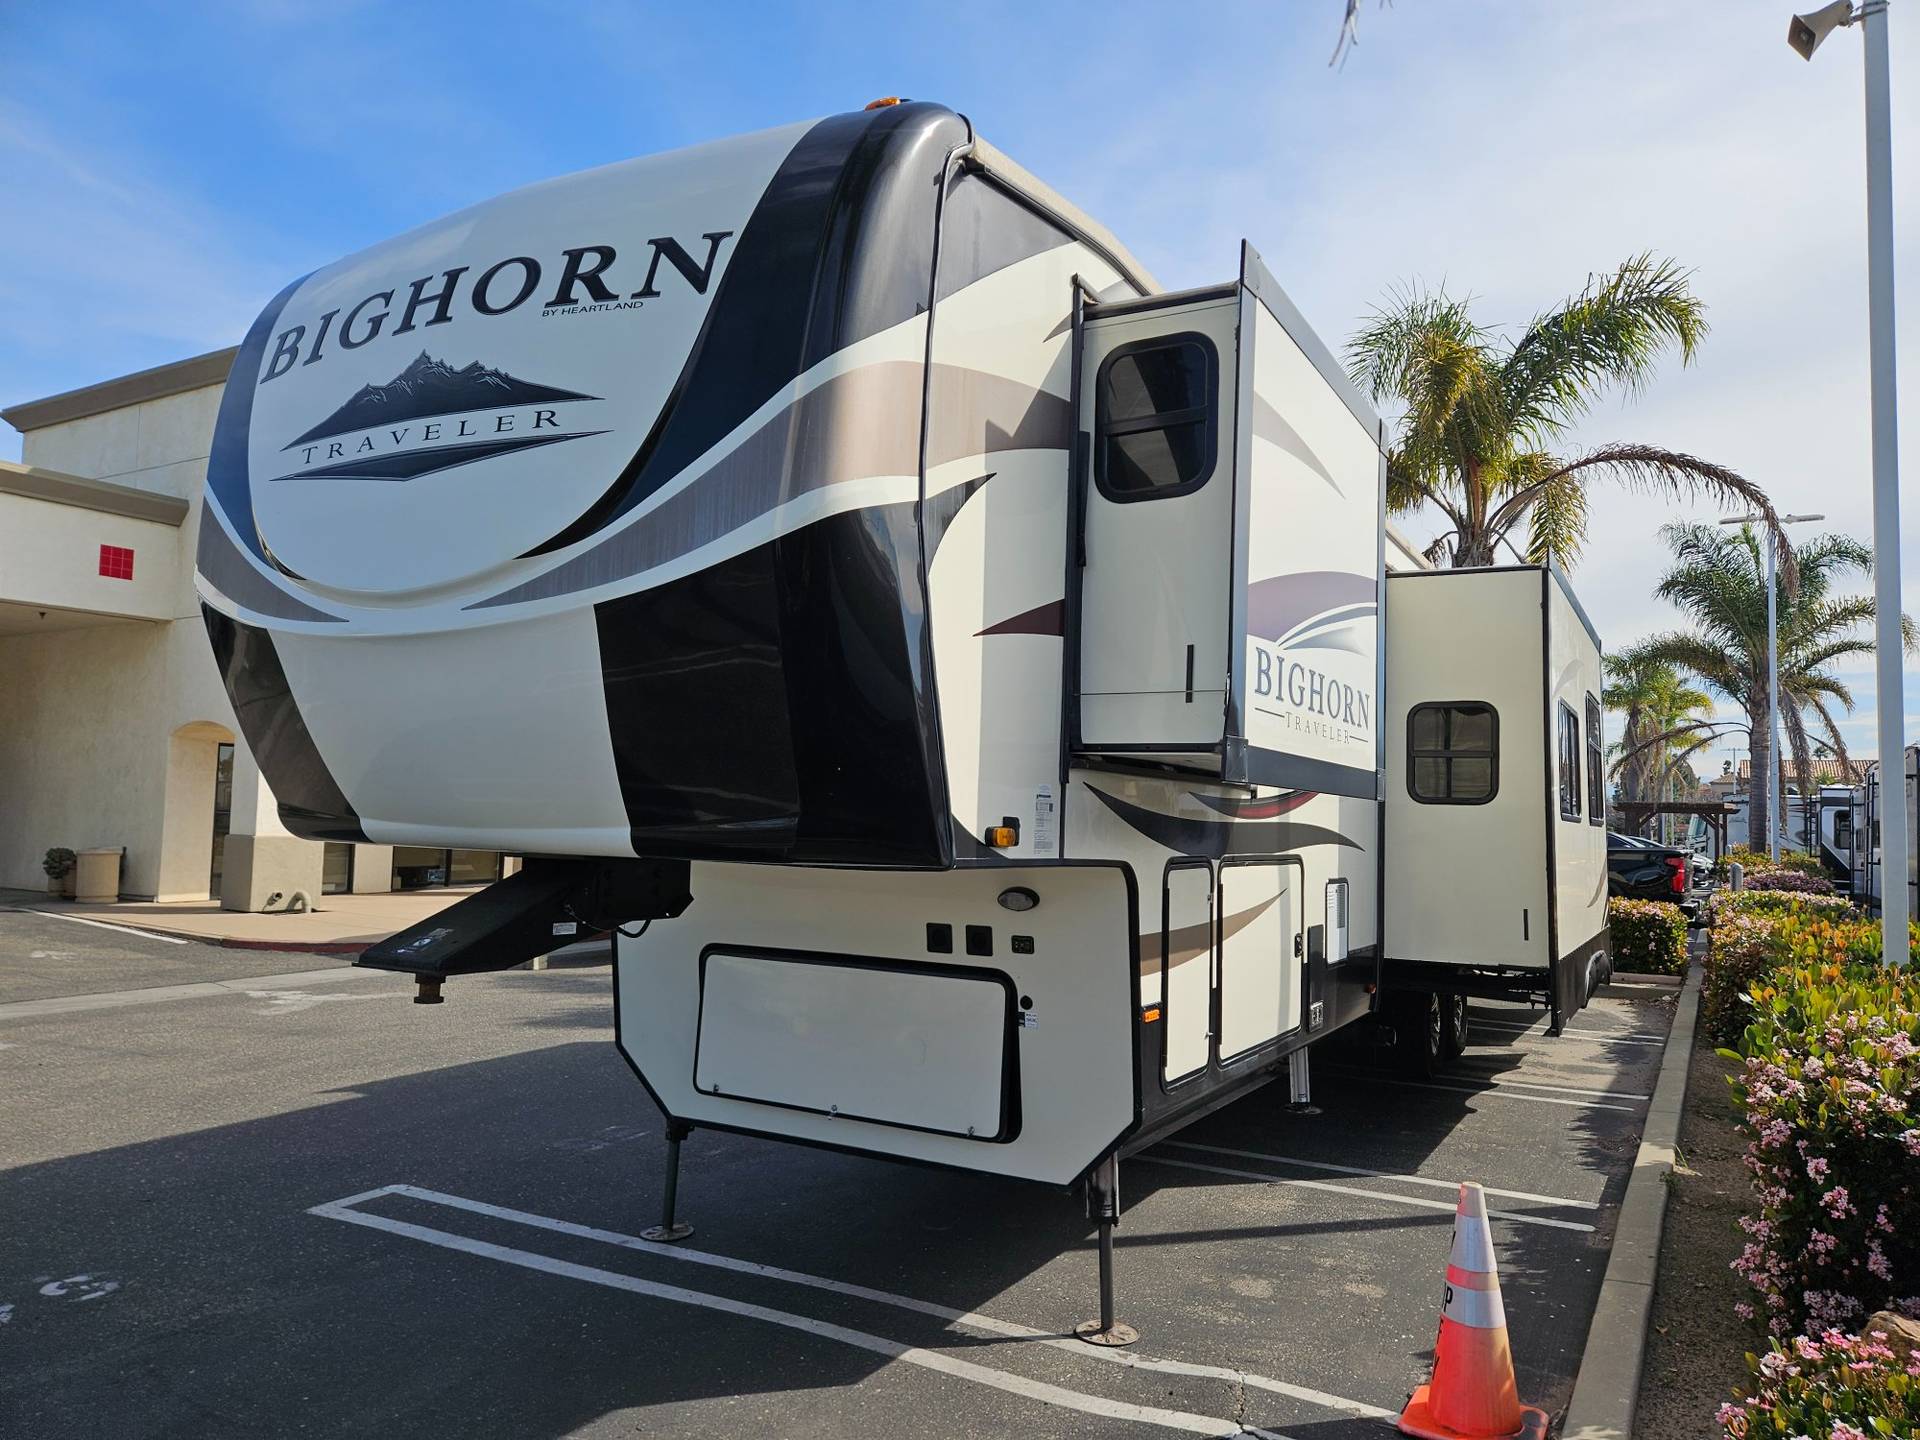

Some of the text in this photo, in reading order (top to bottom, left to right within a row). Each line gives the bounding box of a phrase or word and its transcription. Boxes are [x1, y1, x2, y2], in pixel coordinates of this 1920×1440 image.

[260, 231, 734, 385] BIGHORN
[542, 301, 644, 317] BY HEARTLAND
[302, 410, 560, 464] TRAVELER
[1254, 646, 1370, 730] BIGHORN
[1285, 711, 1350, 744] TRAVELER
